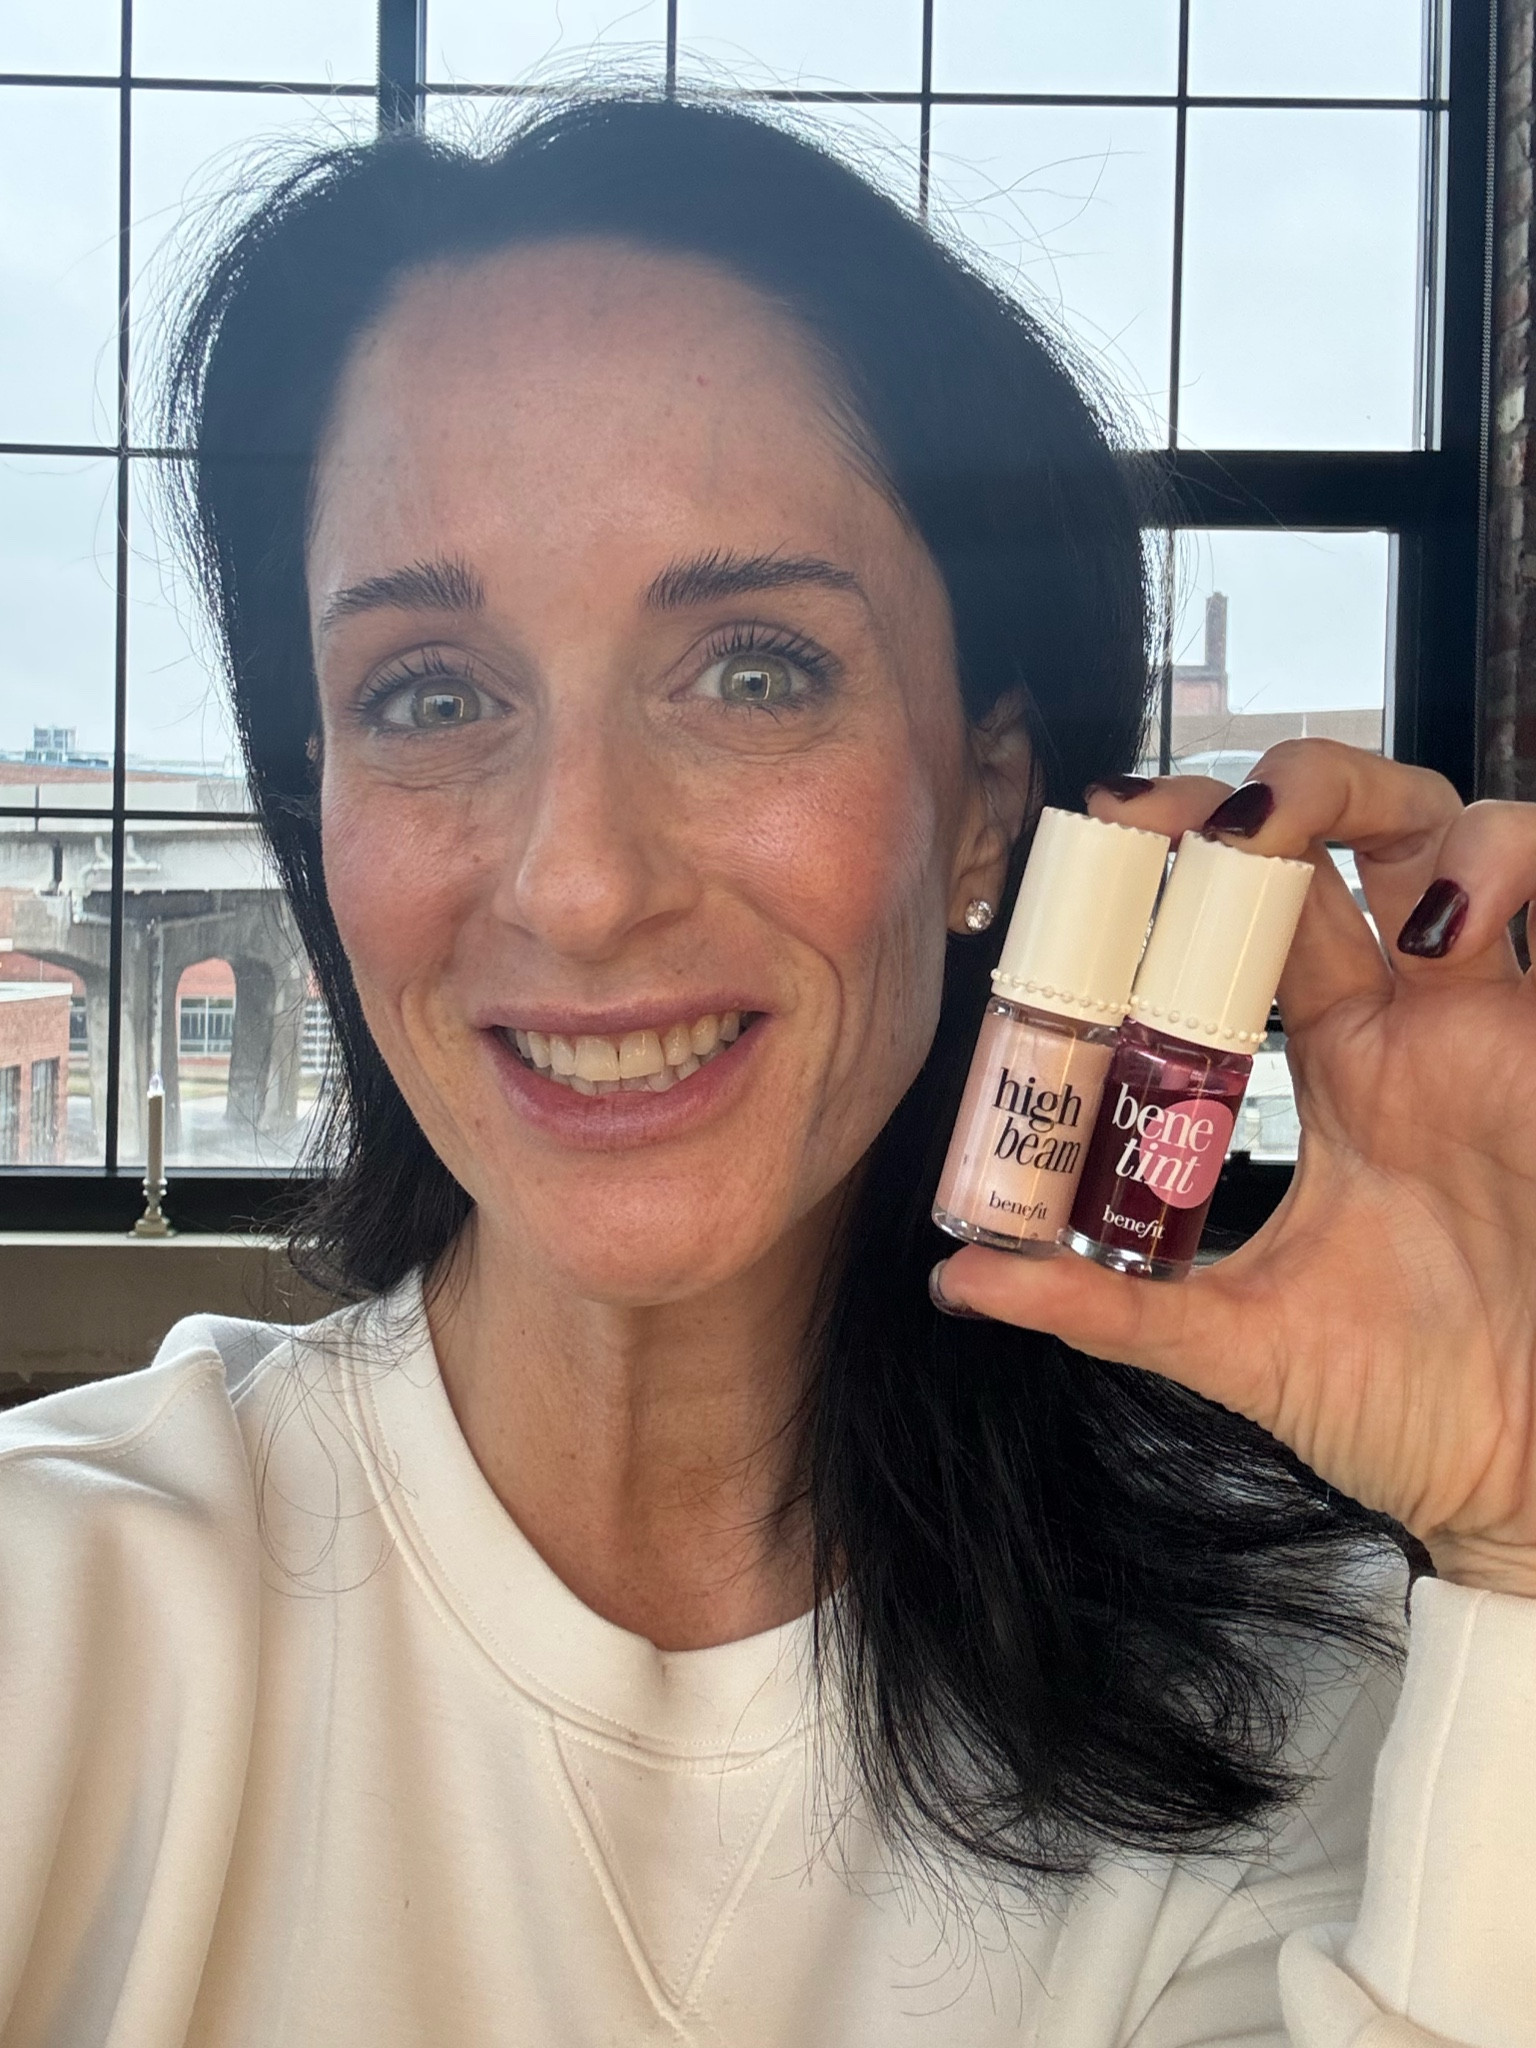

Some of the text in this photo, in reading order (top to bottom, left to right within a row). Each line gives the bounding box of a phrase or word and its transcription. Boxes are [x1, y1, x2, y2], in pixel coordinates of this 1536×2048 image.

[992, 1066, 1082, 1133] high
[1112, 1082, 1214, 1152] bene
[994, 1116, 1081, 1174] beam
[1115, 1138, 1201, 1194] tint
[989, 1191, 1047, 1221] benefit
[1102, 1204, 1166, 1240] benefit
